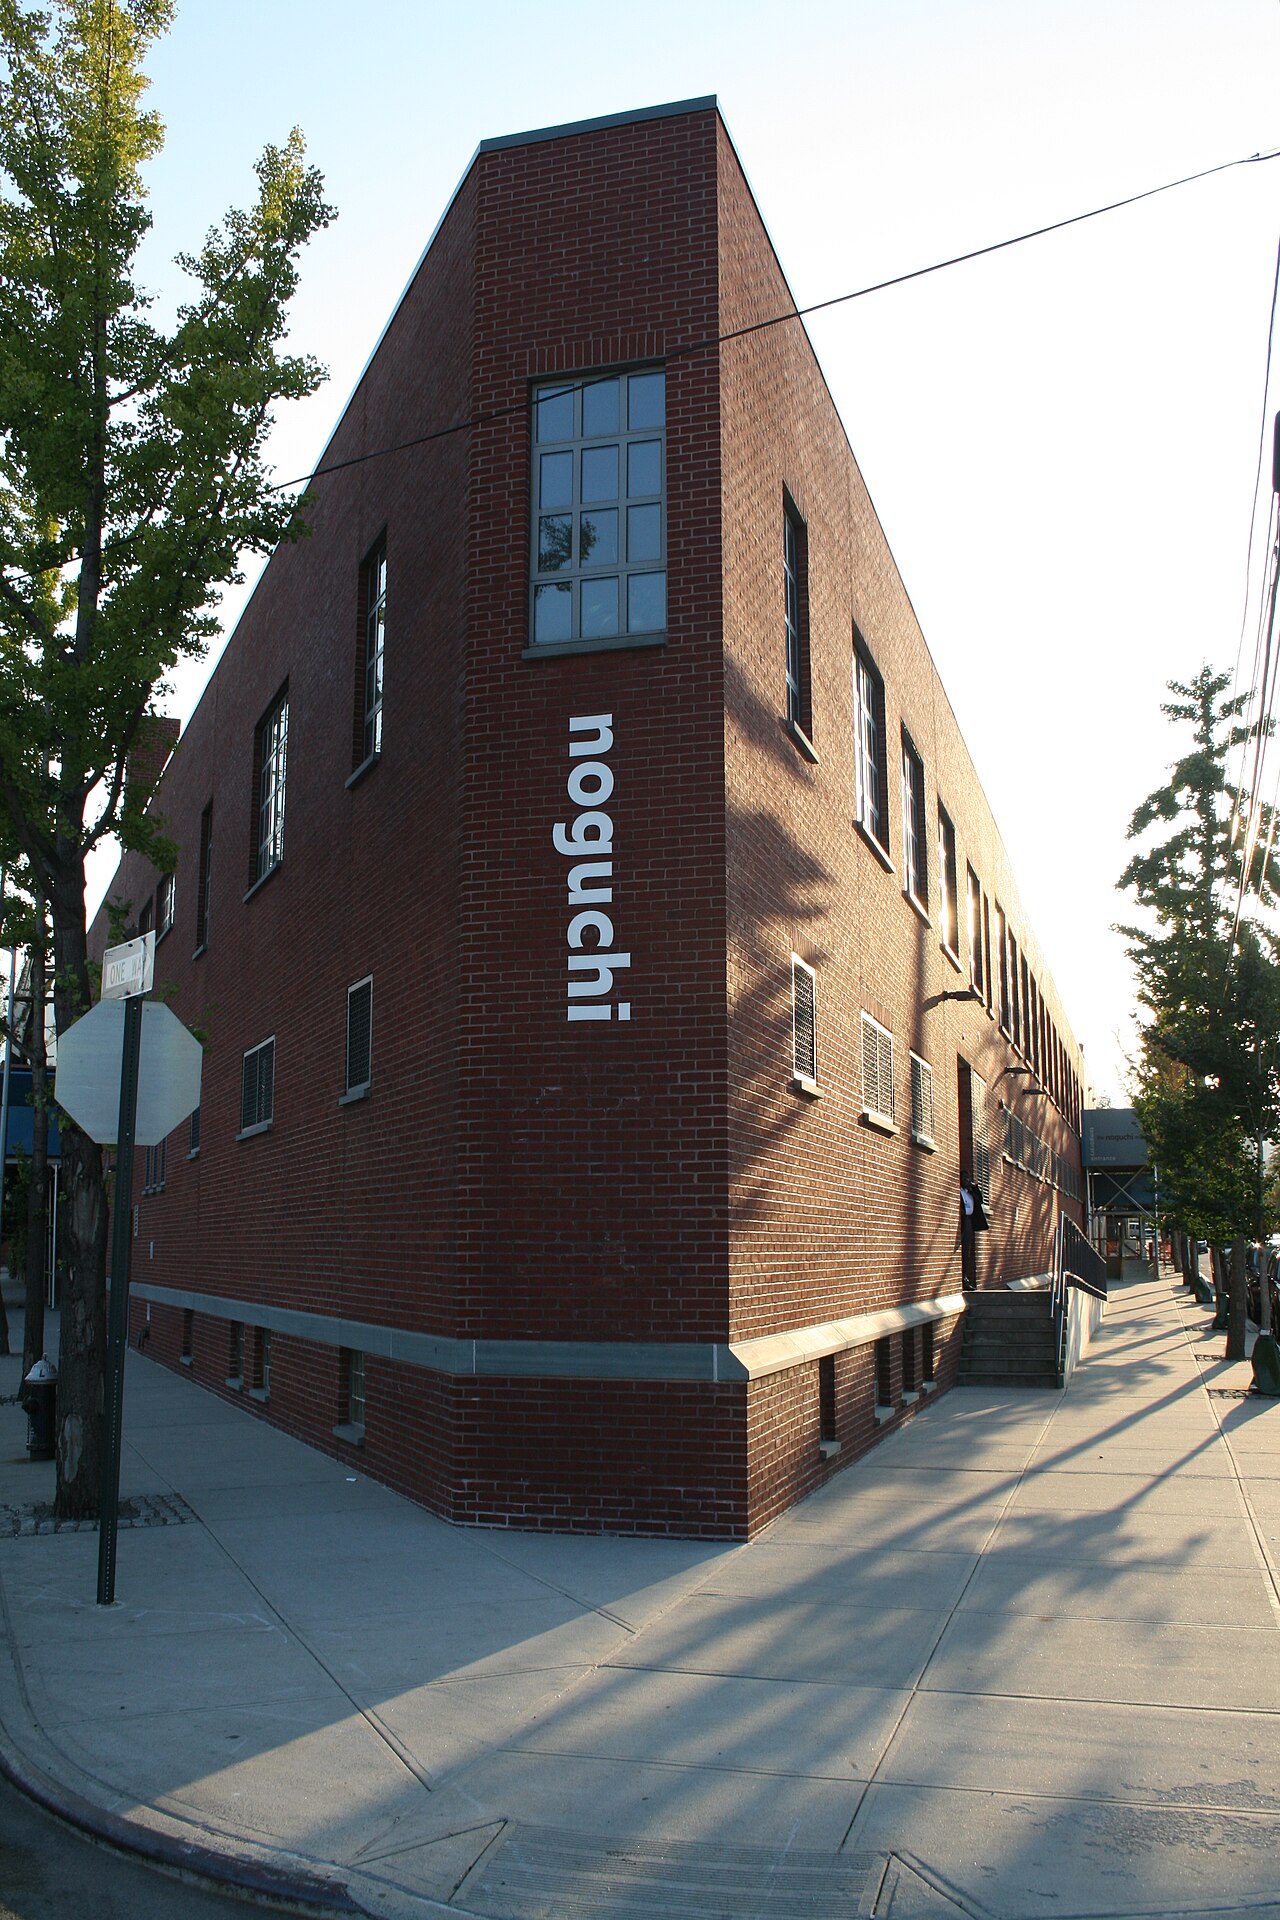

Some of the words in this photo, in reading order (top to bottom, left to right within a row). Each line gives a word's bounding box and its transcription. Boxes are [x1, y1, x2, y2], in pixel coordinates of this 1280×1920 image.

[552, 713, 631, 1022] noguchi
[110, 961, 126, 985] ONE
[131, 952, 145, 978] WA
[1105, 1133, 1134, 1141] noguchi
